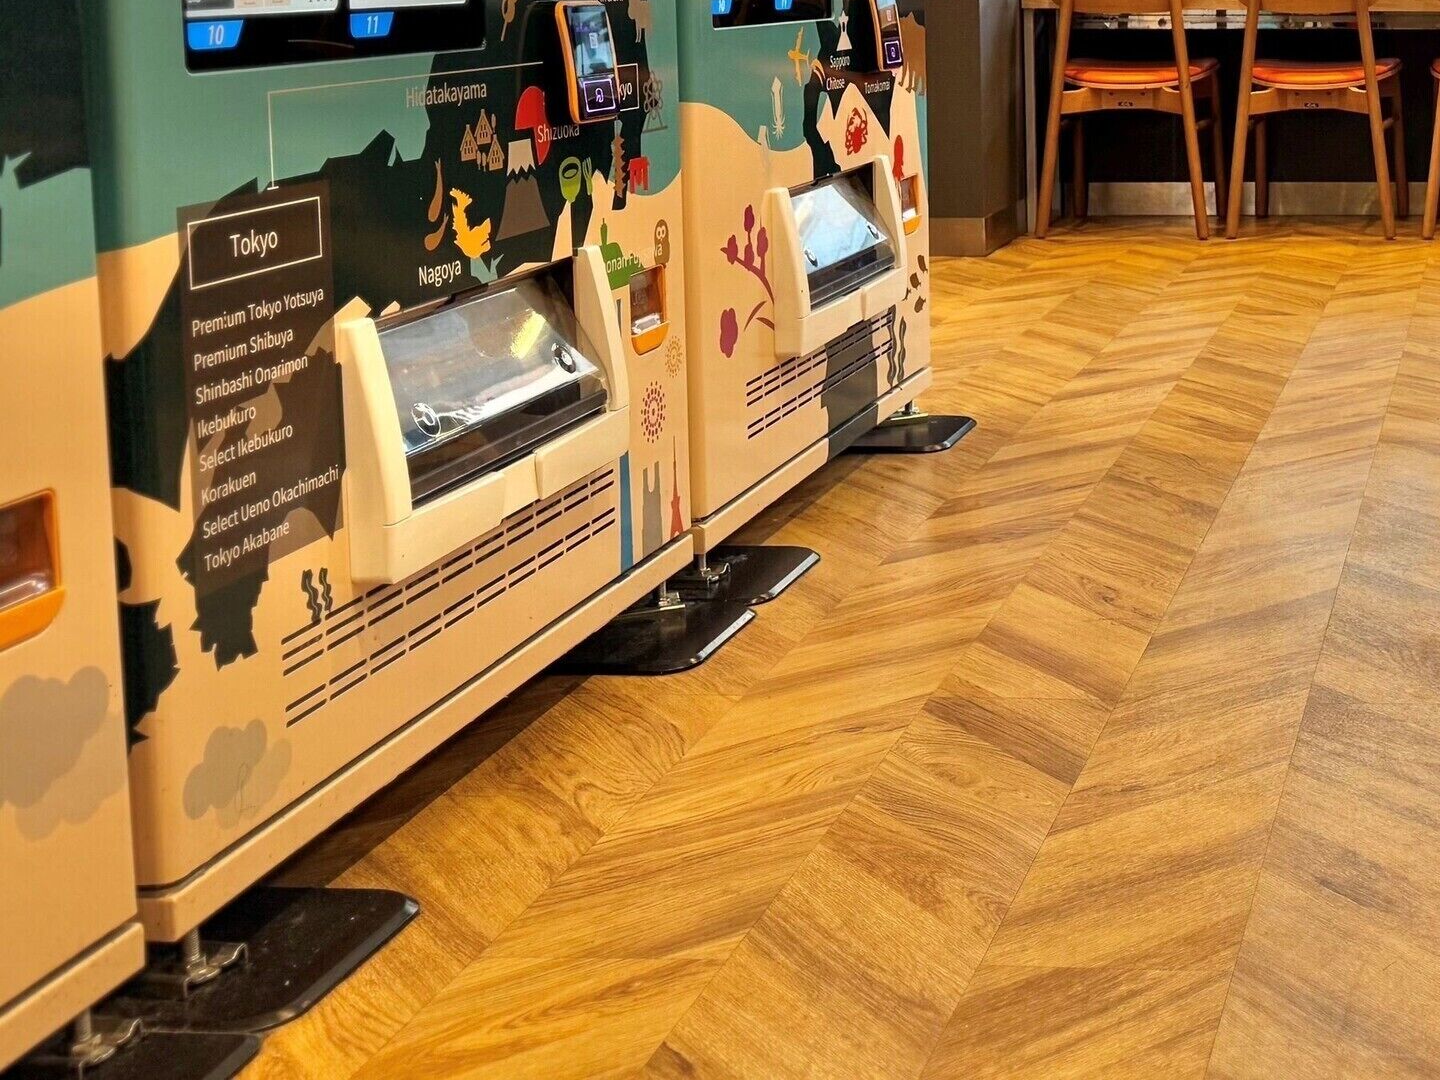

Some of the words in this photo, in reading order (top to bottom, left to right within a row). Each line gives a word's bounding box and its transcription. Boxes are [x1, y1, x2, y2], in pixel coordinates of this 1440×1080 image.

[208, 24, 225, 46] 10
[367, 15, 379, 34] 11
[829, 55, 851, 71] Sapporo
[406, 82, 488, 108] Hidatakayama
[619, 81, 633, 104] kyo
[826, 77, 845, 91] Chitose
[863, 78, 891, 94] Tomakomai
[537, 123, 581, 143] Shizuoka
[229, 229, 278, 258] Tokyo
[418, 259, 462, 288] Nagoya
[606, 255, 626, 274] onan
[191, 311, 247, 337] Premium
[247, 299, 282, 322] Tokyo
[283, 286, 324, 312] Yotsuya
[194, 344, 248, 371] Premium
[250, 326, 294, 354] Shibuya
[195, 371, 253, 405] Shinbashi
[255, 354, 308, 384] Onarimon
[197, 405, 257, 438] Ikebukuro
[199, 446, 235, 472] Select
[237, 424, 293, 456] Ikebukuro
[201, 471, 257, 505] Korakuen
[203, 513, 239, 539] Select
[241, 497, 270, 522] Ueno
[272, 464, 340, 508] Okachimachi
[204, 544, 240, 571] Tokyo
[242, 520, 290, 555] Akabane
